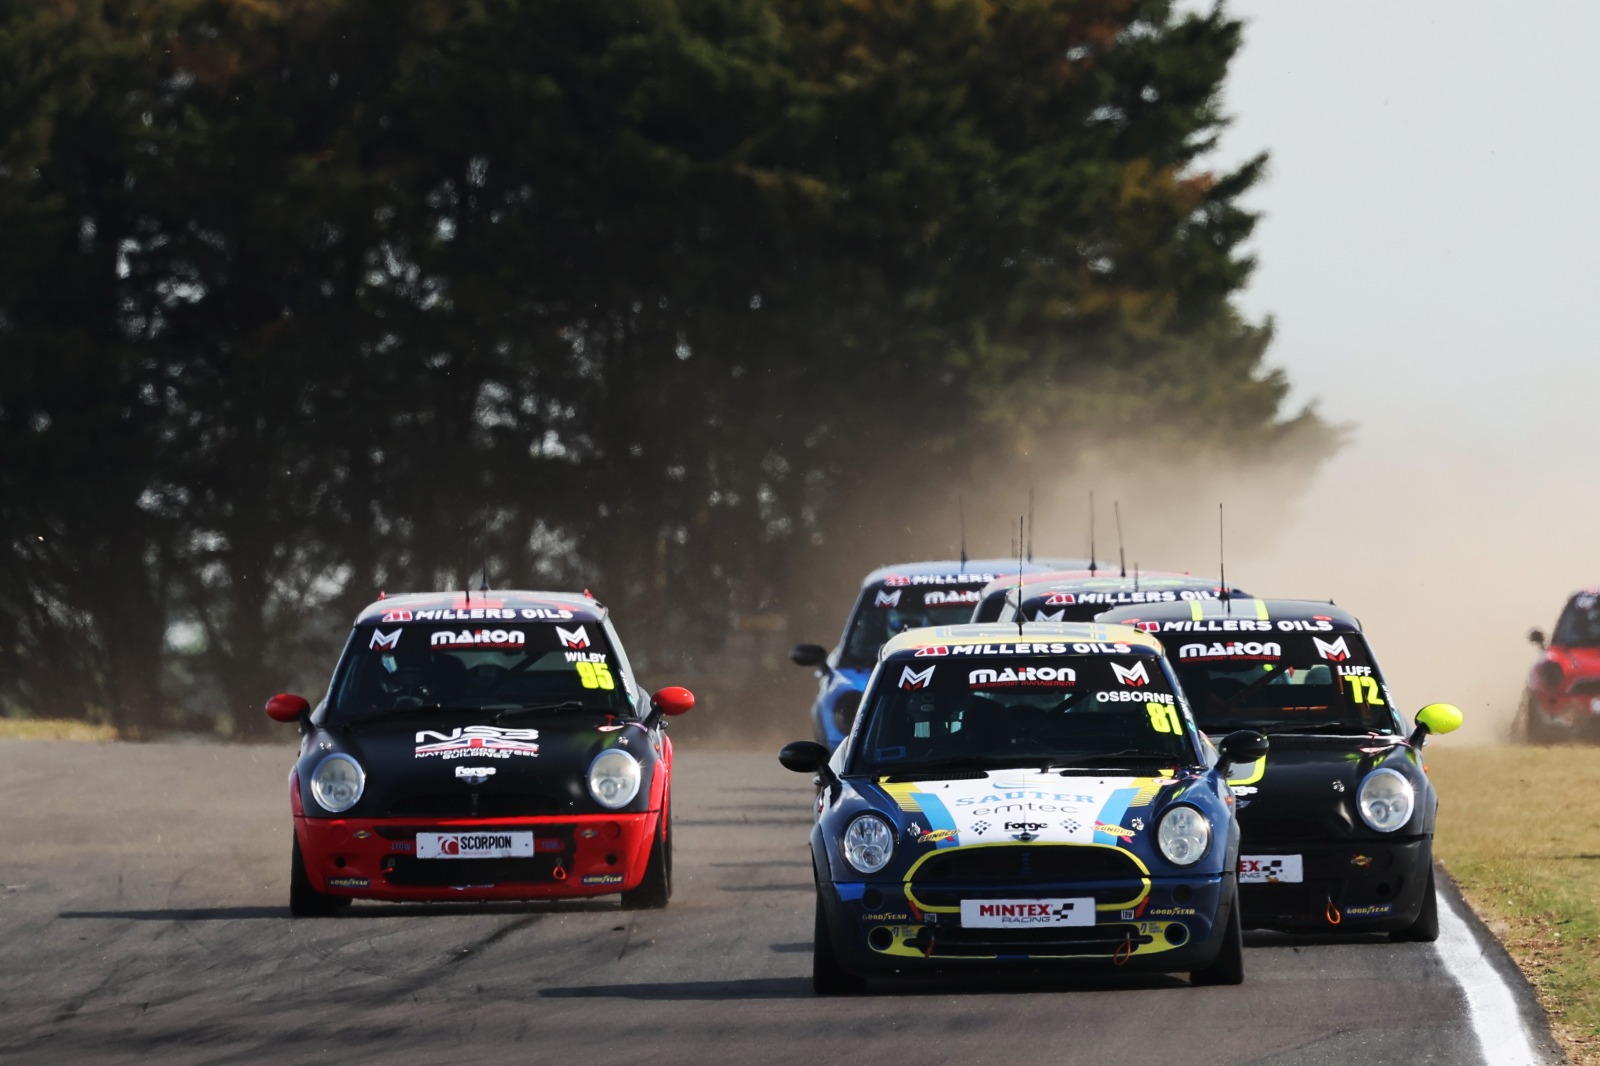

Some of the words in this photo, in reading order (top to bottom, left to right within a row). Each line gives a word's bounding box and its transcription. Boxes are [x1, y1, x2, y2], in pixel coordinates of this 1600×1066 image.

[911, 573, 995, 585] MILLERS
[1078, 591, 1176, 604] MILLERS
[415, 608, 517, 620] MILLERS
[522, 608, 574, 620] OILS
[1162, 620, 1273, 632] MILLERS
[1277, 620, 1334, 632] OILS
[952, 643, 1069, 656] MILLERS
[1073, 643, 1131, 655] OILS
[564, 651, 607, 664] WILBY
[575, 662, 615, 690] 95
[1337, 665, 1371, 676] LUFF
[1344, 676, 1384, 705] 72
[1096, 691, 1174, 705] OSBORNE
[1145, 702, 1183, 736] 81
[955, 791, 1095, 806] SAUTER
[972, 803, 1079, 816] emtec
[918, 830, 958, 843] SUNOCO
[1093, 824, 1136, 836] SUNOCO
[460, 835, 512, 850] SCORPION
[979, 904, 1050, 916] MINTEX
